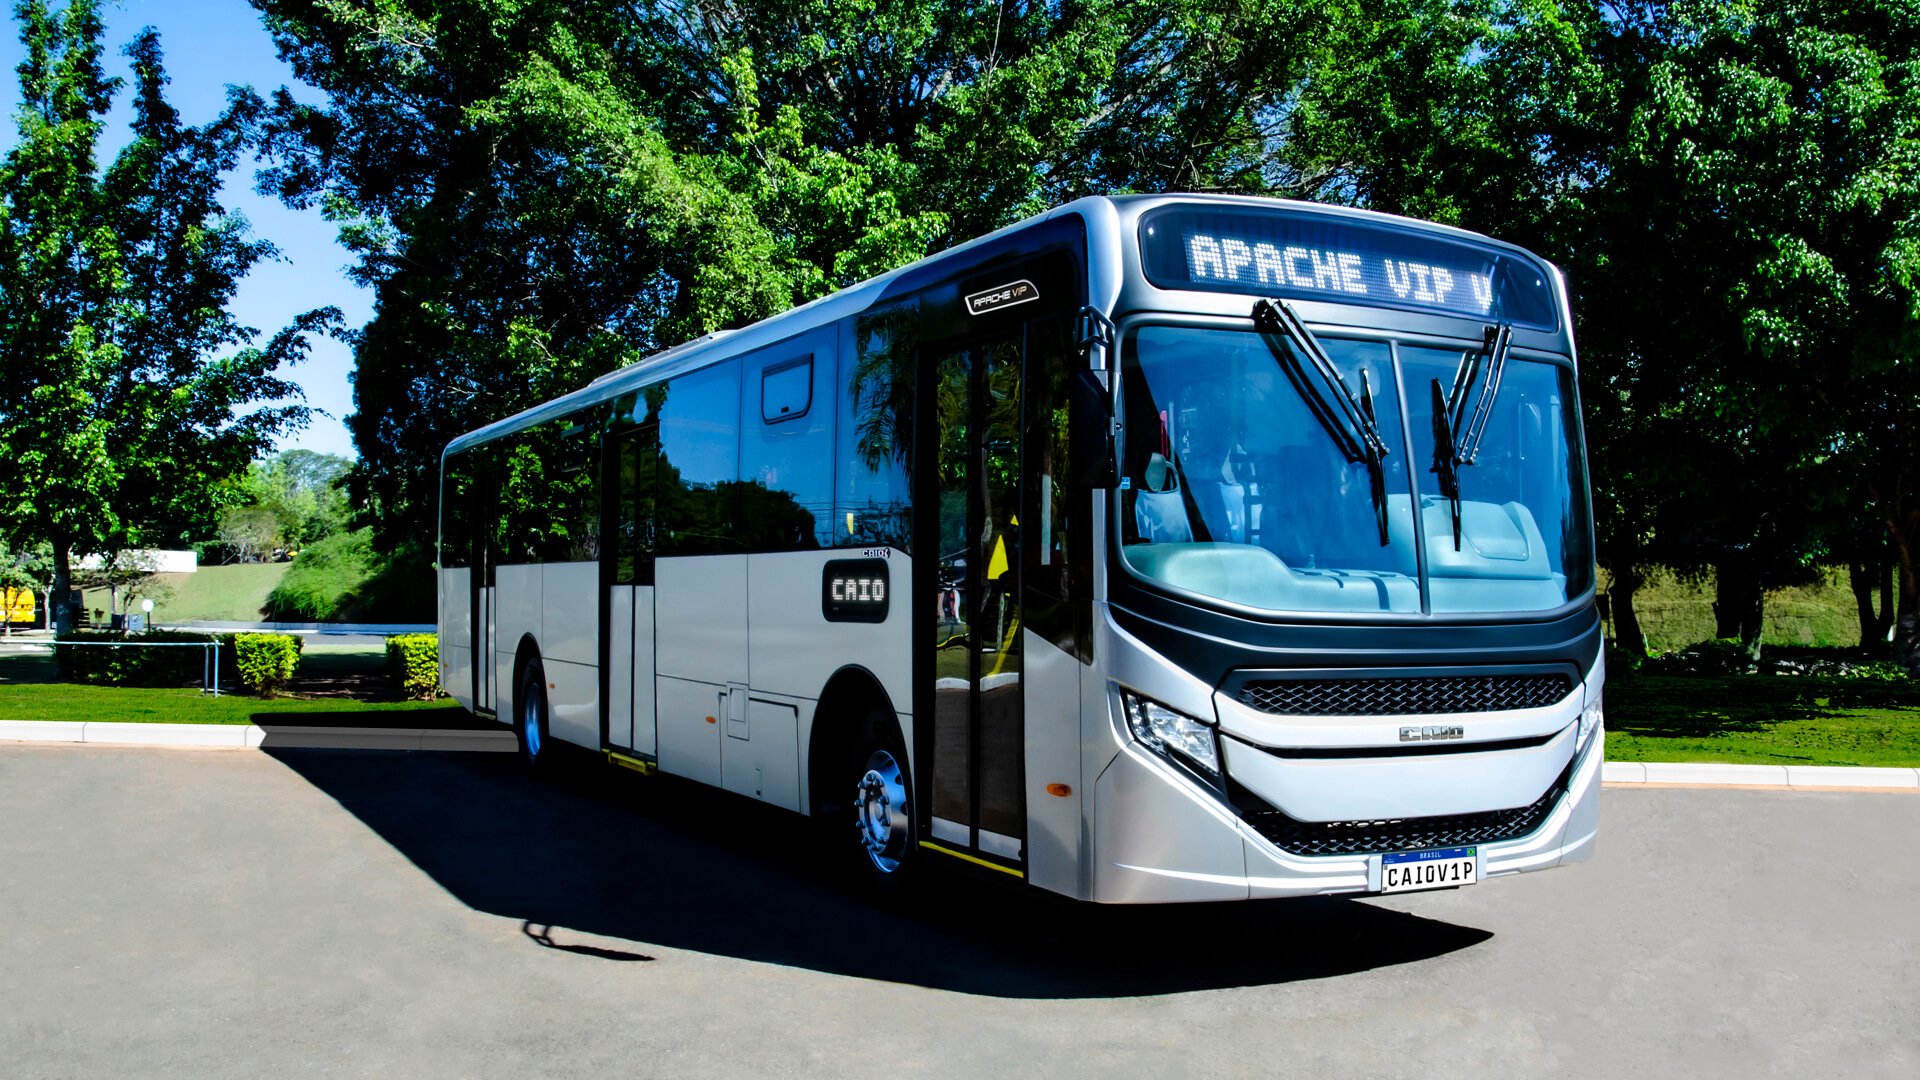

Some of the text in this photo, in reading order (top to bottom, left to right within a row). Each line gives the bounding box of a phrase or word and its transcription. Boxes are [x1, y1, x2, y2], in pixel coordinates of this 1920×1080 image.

[1190, 234, 1367, 294] APACHE
[1384, 259, 1454, 303] VIP
[973, 285, 1027, 308] APACHE VIP
[863, 549, 886, 557] CAIO
[832, 579, 884, 601] CAIO
[1399, 725, 1464, 742] CAIO
[1388, 861, 1473, 887] CAIOV1P
